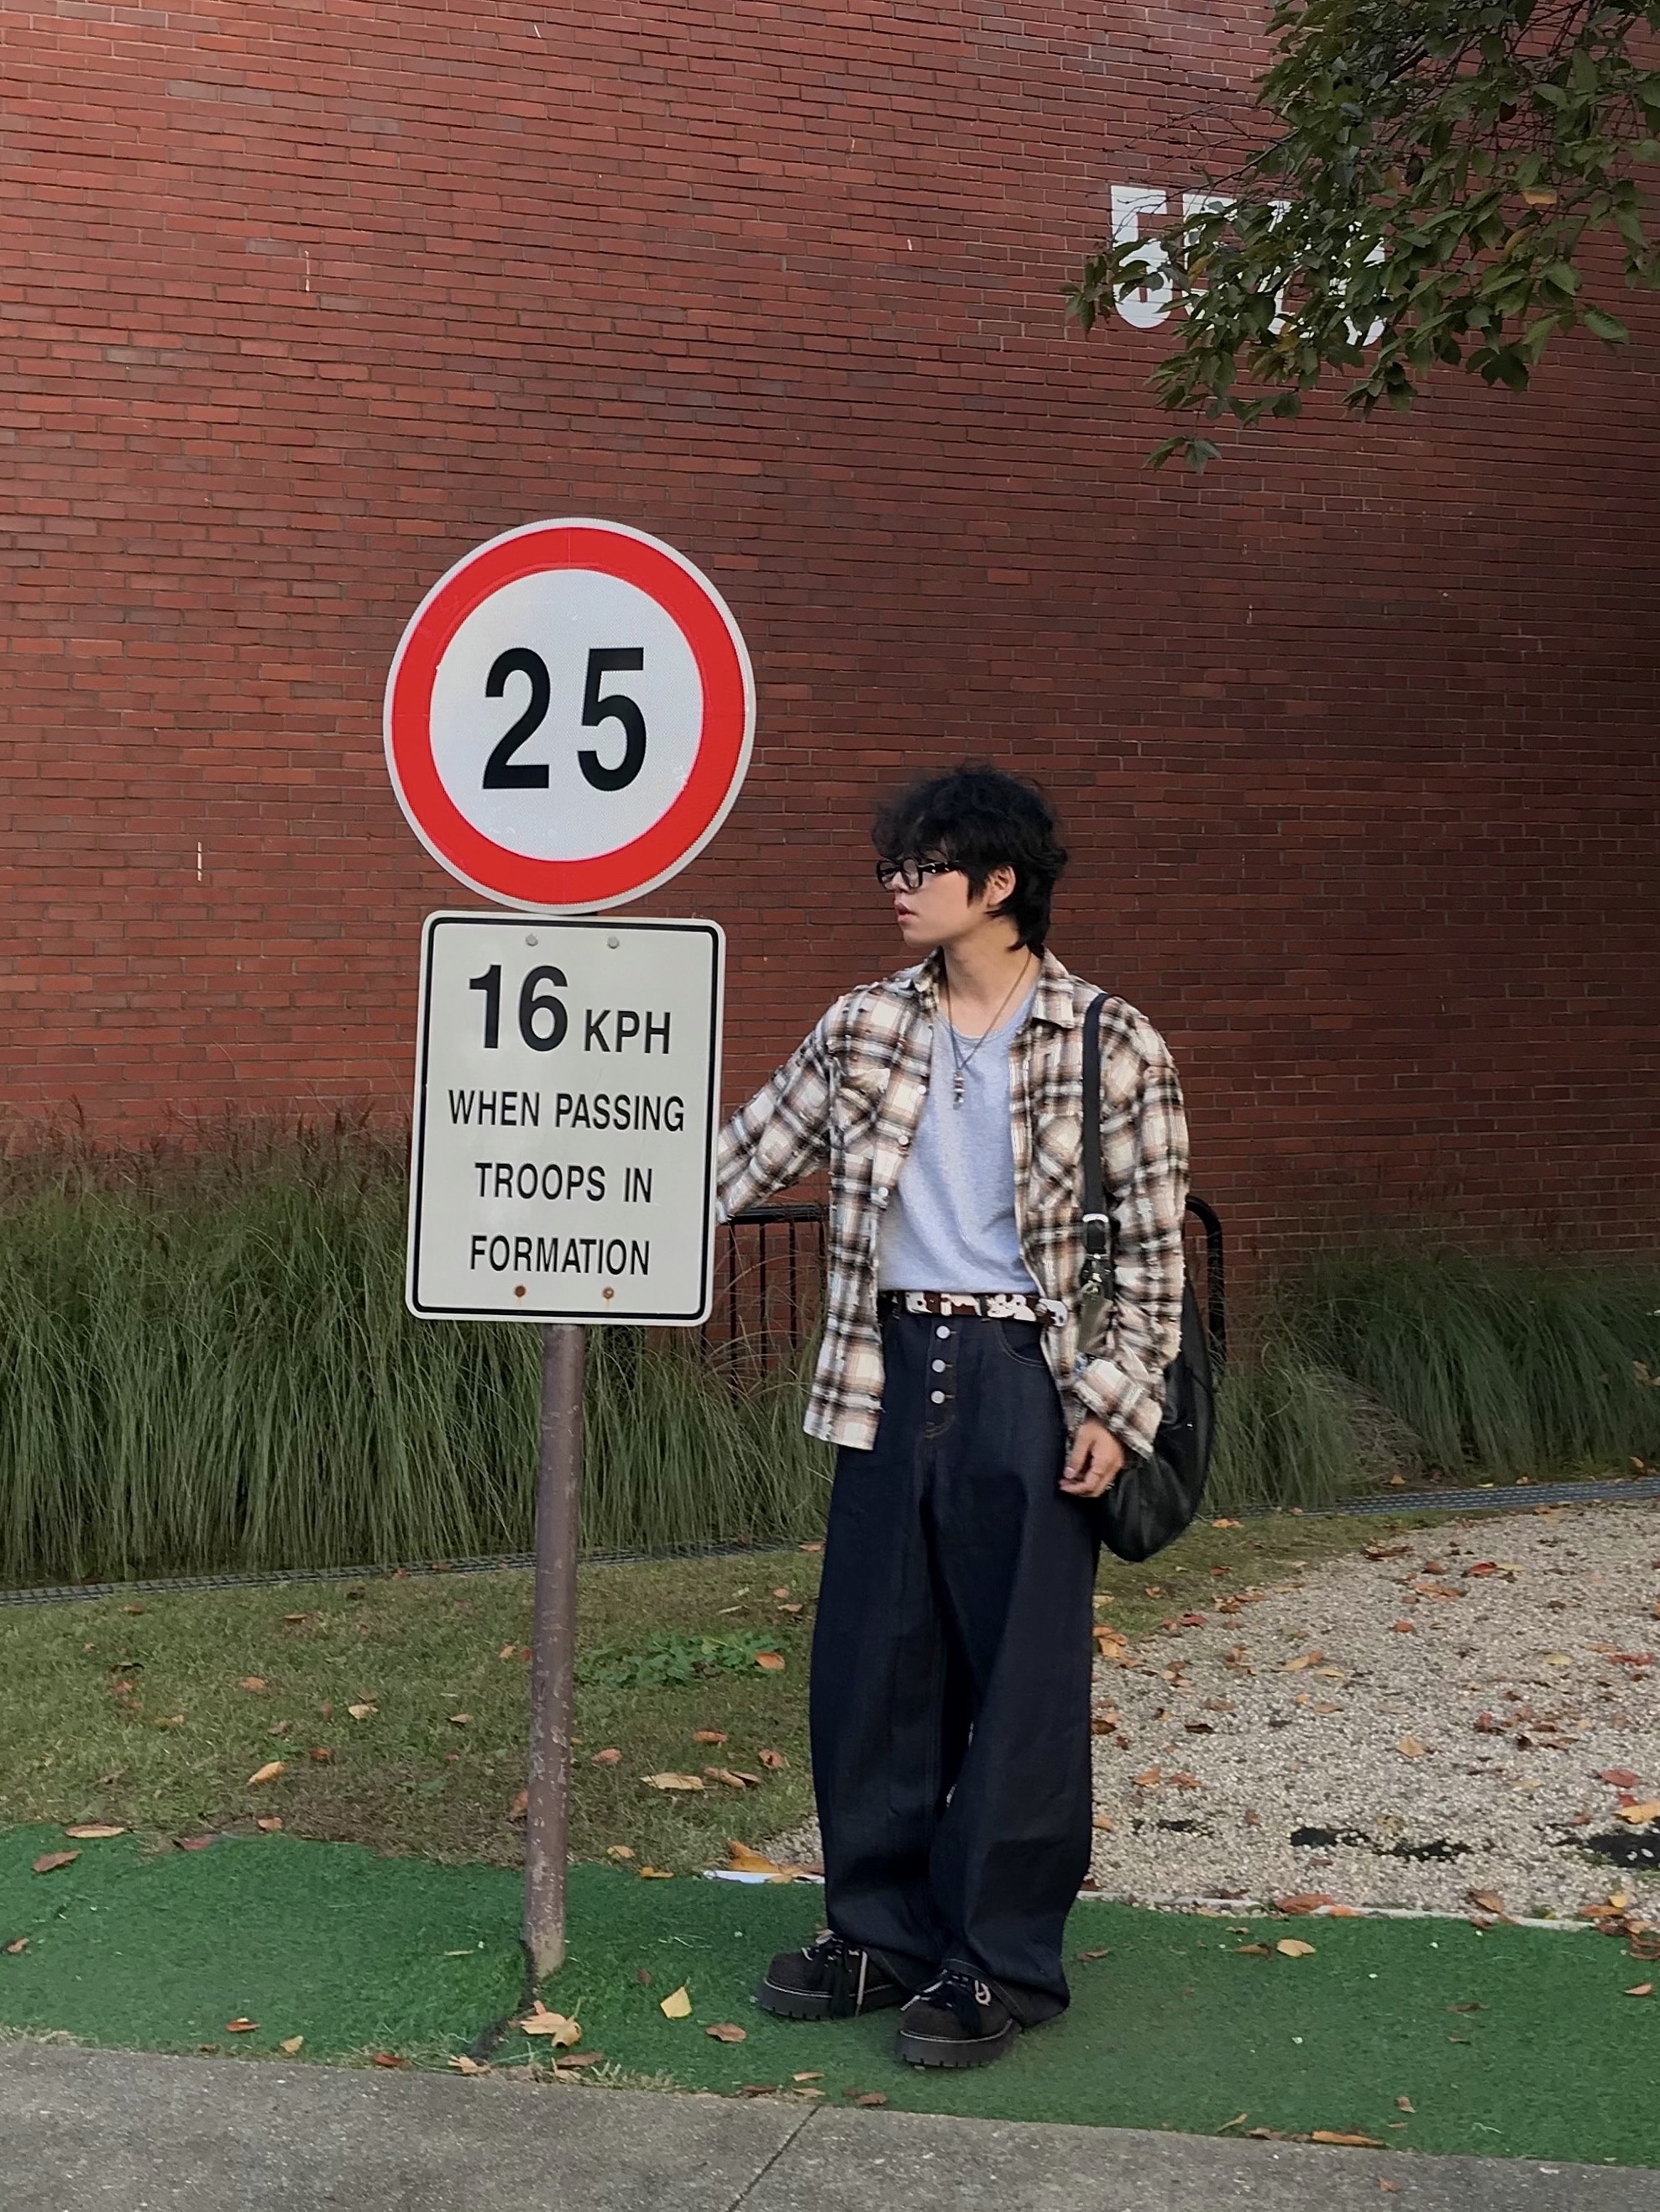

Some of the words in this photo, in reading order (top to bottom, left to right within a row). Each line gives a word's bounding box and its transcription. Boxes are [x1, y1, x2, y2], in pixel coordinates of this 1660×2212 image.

[482, 647, 647, 792] 25
[469, 964, 568, 1052] 16
[584, 1009, 671, 1055] KPH
[448, 1089, 540, 1127] WHEN
[555, 1093, 684, 1132] PASSING
[474, 1162, 605, 1202] TROOPS
[625, 1167, 652, 1203] IN
[470, 1234, 650, 1276] FORMATION
